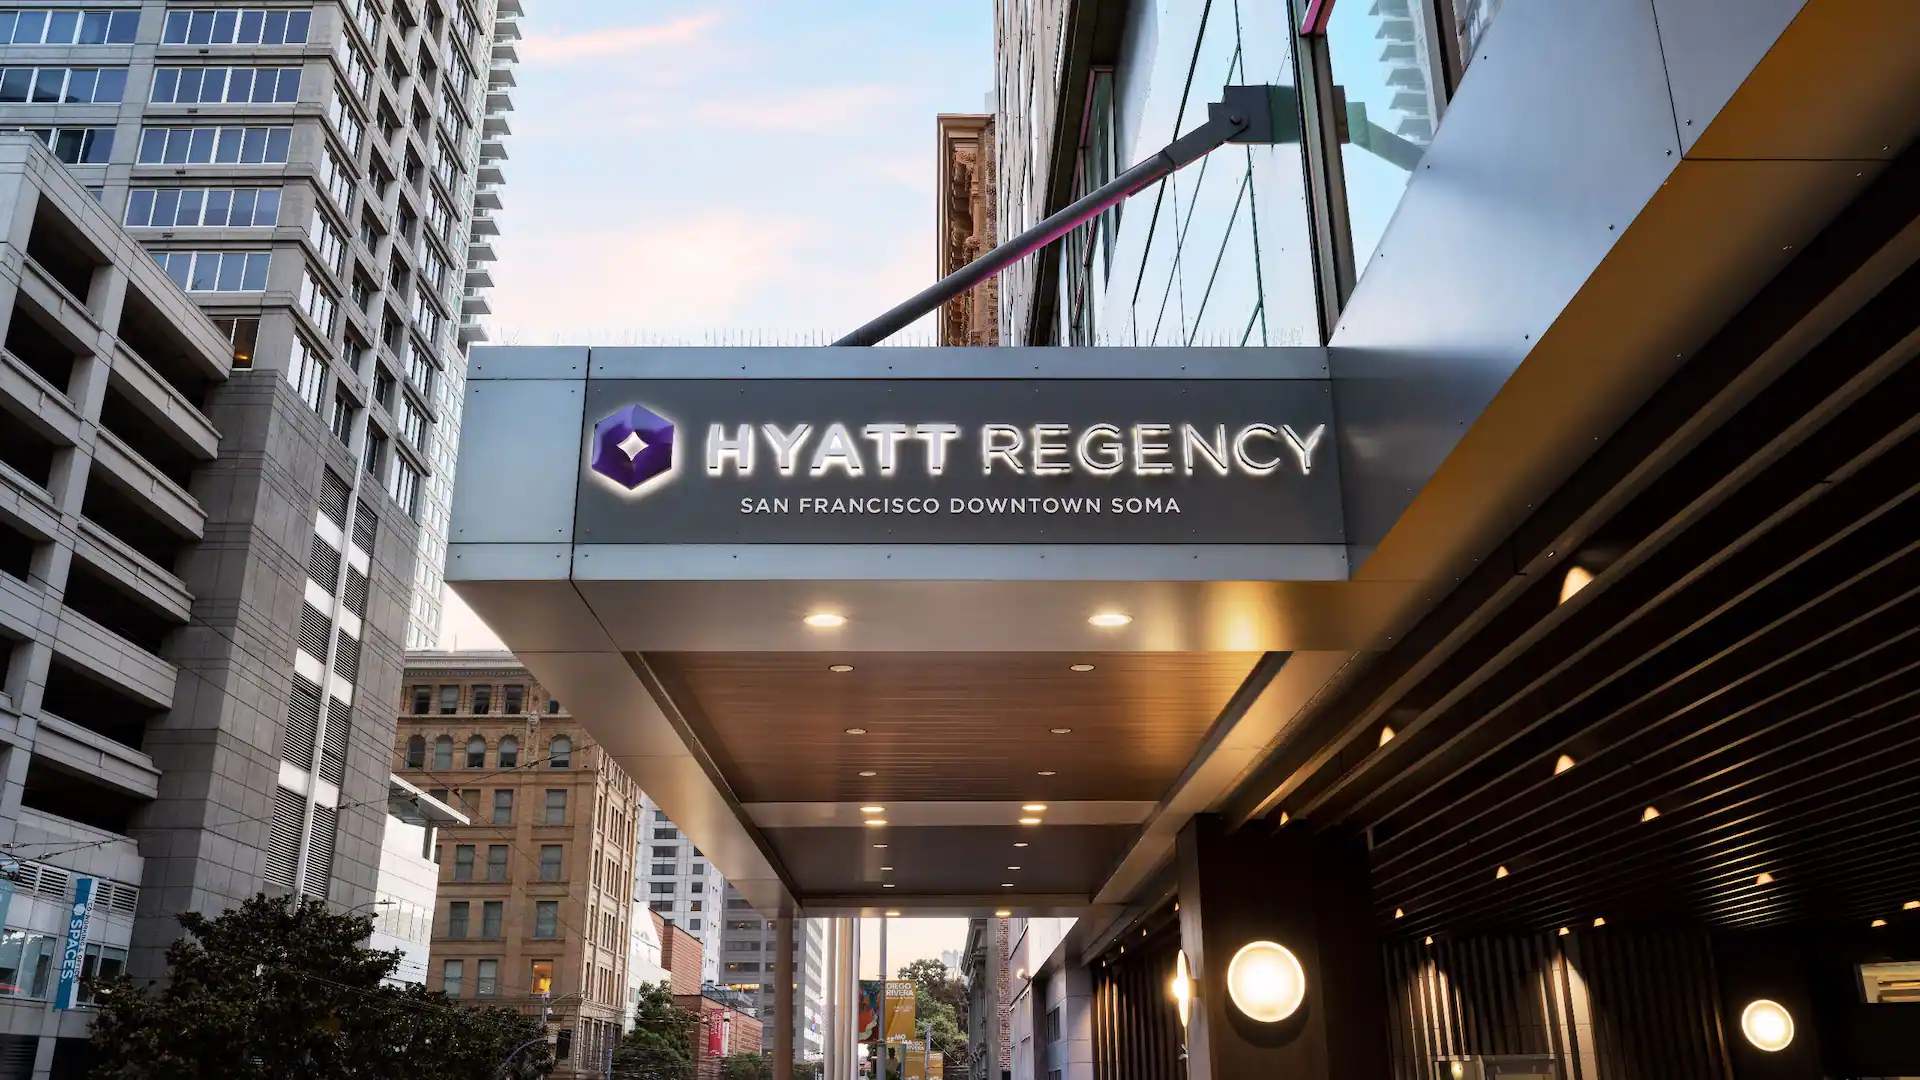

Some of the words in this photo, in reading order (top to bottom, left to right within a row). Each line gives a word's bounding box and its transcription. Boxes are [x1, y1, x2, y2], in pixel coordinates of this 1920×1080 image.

[707, 423, 959, 474] HYATT
[983, 423, 1326, 474] REGENCY
[740, 497, 790, 515] SAN
[799, 497, 940, 515] FRANCISCO
[949, 497, 1102, 515] DOWNTOWN
[1111, 497, 1181, 515] SOMA
[886, 982, 912, 990] DIEGO
